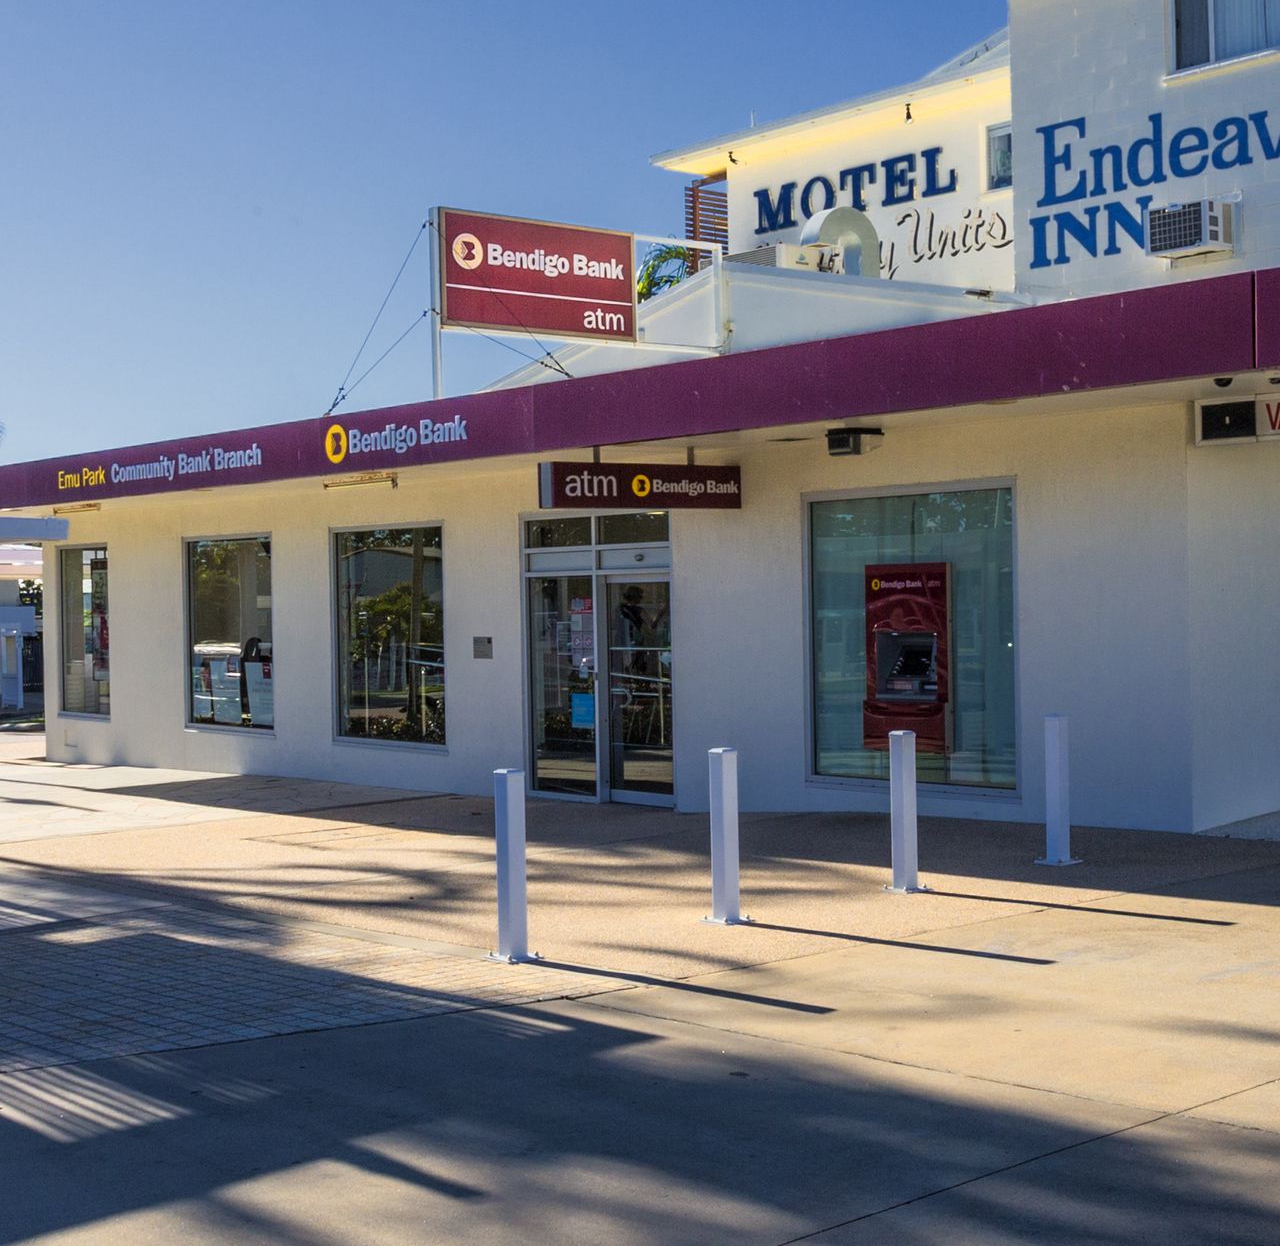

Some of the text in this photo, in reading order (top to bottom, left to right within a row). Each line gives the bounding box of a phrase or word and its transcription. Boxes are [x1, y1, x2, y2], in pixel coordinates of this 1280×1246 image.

[753, 146, 959, 235] MOTEL
[896, 207, 1015, 263] Units
[1028, 194, 1154, 270] INN
[487, 243, 625, 280] Bendigo Bank
[583, 308, 625, 331] atm
[348, 414, 468, 454] Bendigo Bank
[58, 470, 81, 490] Emu
[82, 466, 106, 487] Park
[111, 455, 176, 482] Community
[214, 443, 262, 471] Branch
[564, 470, 618, 497] atm
[652, 479, 740, 496] Bendigo Bank
[880, 580, 905, 589] Bendigo
[905, 579, 923, 588] Bank
